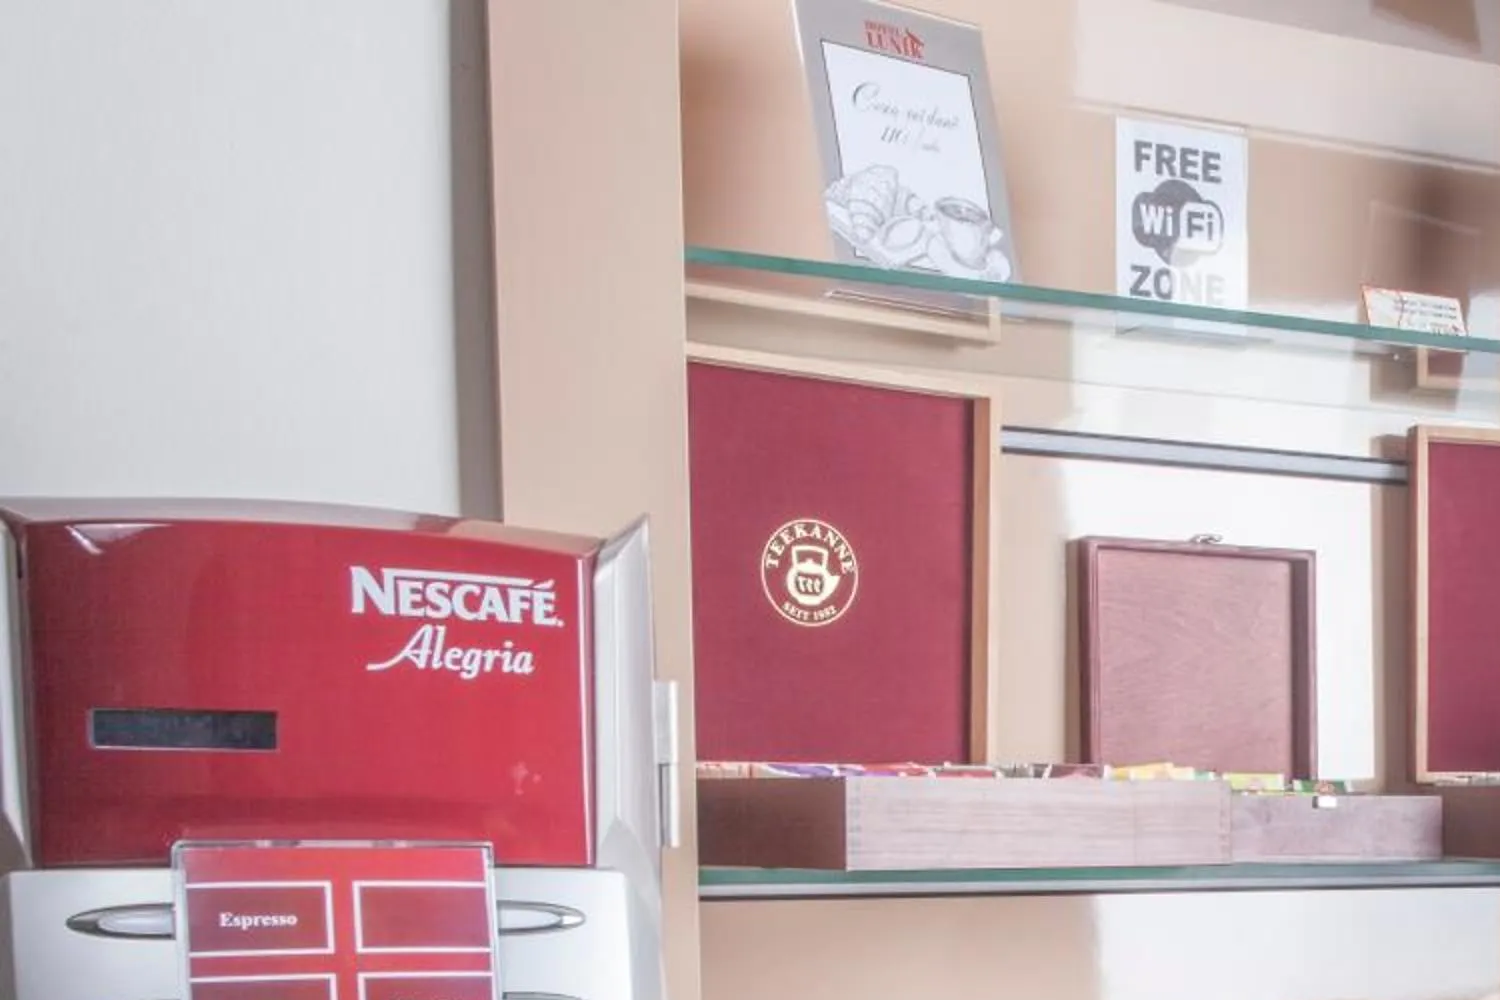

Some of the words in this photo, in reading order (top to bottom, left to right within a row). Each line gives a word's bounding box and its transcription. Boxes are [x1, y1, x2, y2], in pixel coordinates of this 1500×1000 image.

[1133, 140, 1222, 184] FREE
[766, 523, 857, 575] TEEKANNE
[366, 624, 534, 679] Alegria
[218, 912, 298, 931] Espresso
